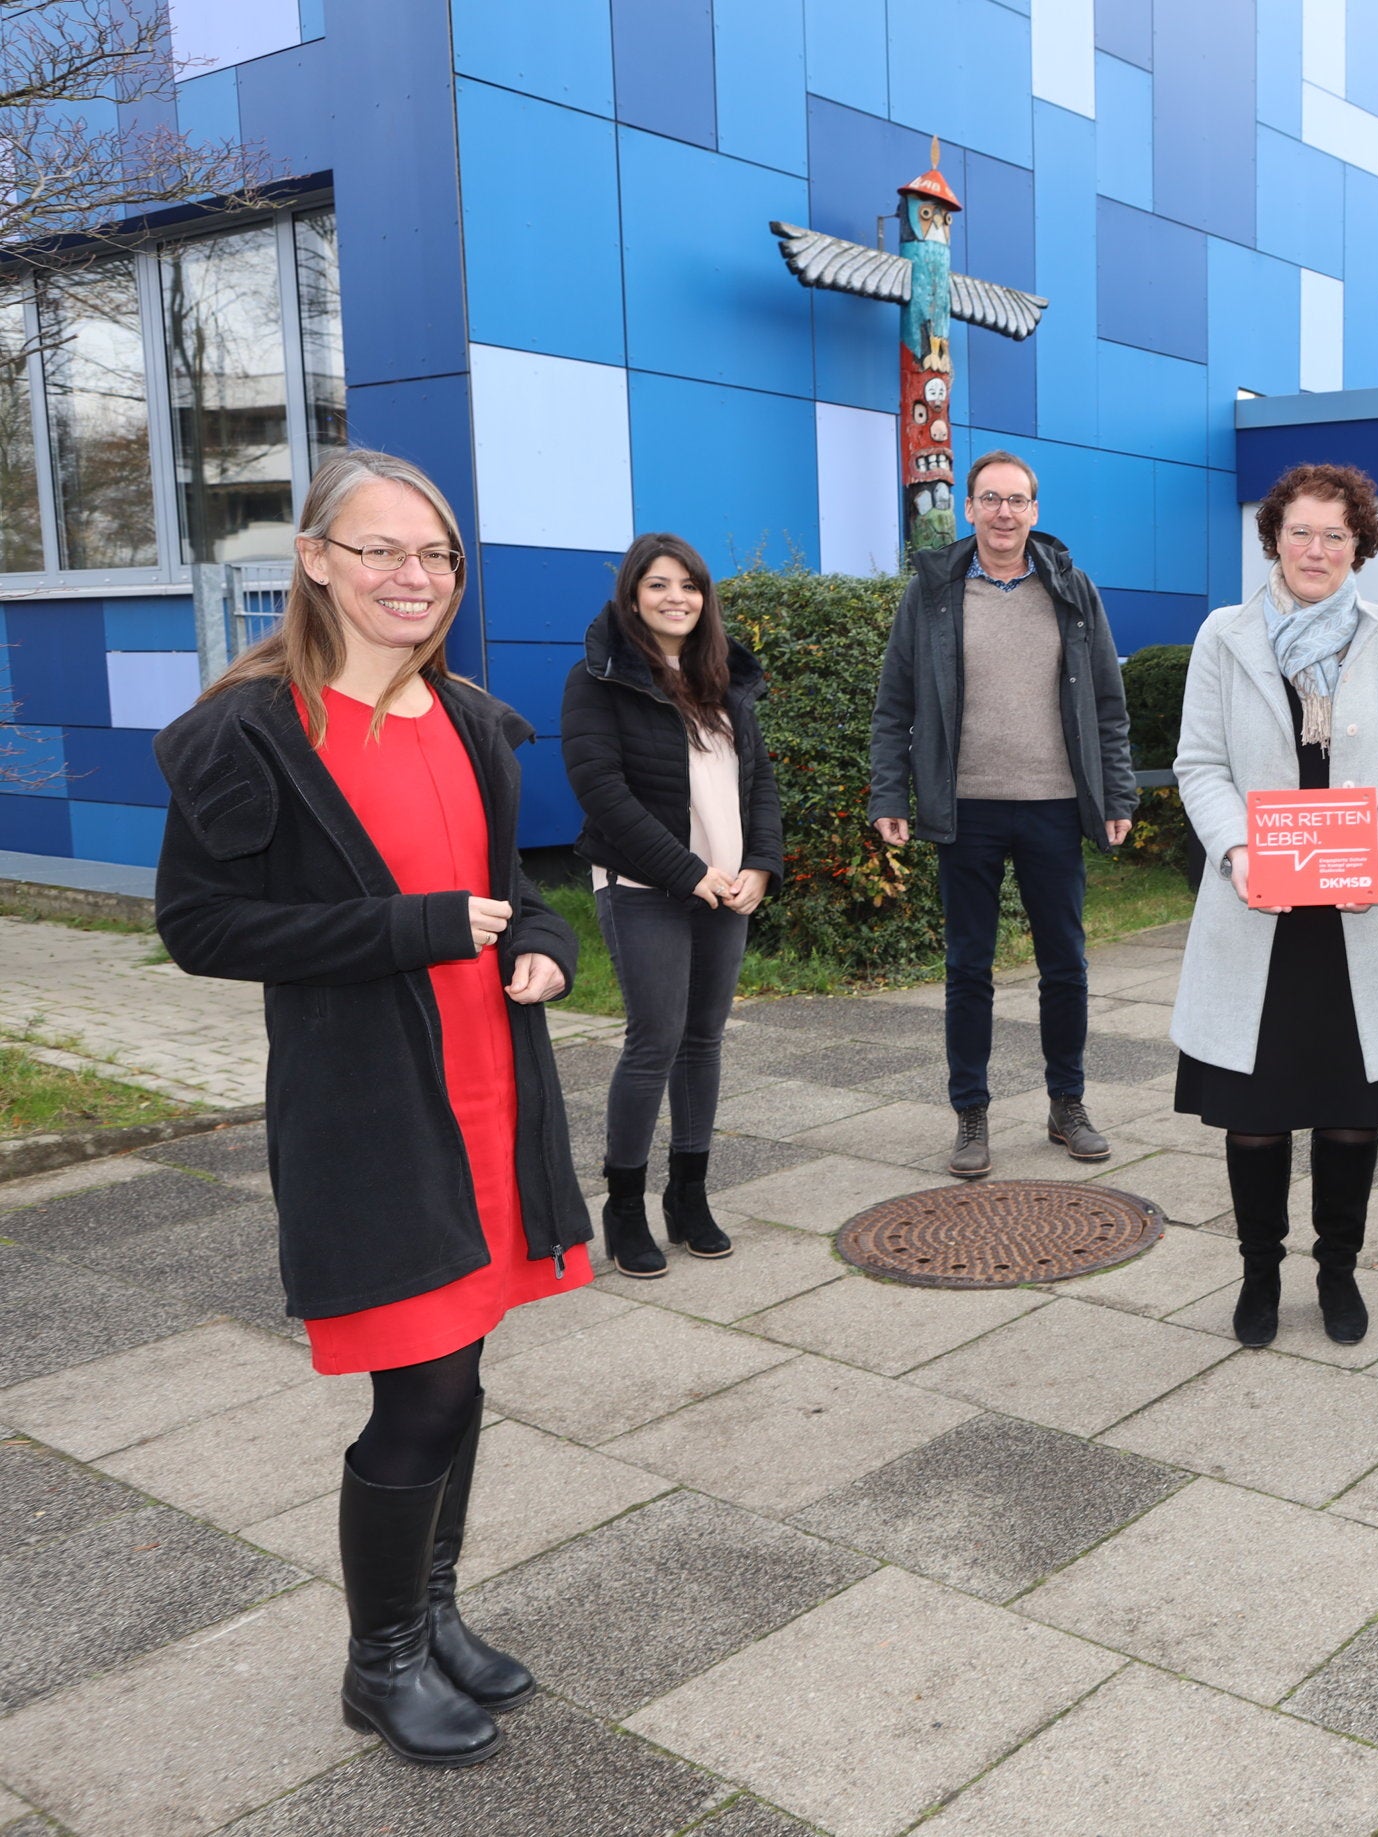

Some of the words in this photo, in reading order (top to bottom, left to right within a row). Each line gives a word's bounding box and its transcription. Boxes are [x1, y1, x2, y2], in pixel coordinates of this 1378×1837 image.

[1256, 813, 1293, 827] WIR
[1298, 811, 1371, 826] RETTEN
[1256, 831, 1322, 846] LEBEN.
[1320, 877, 1359, 889] DKMS
